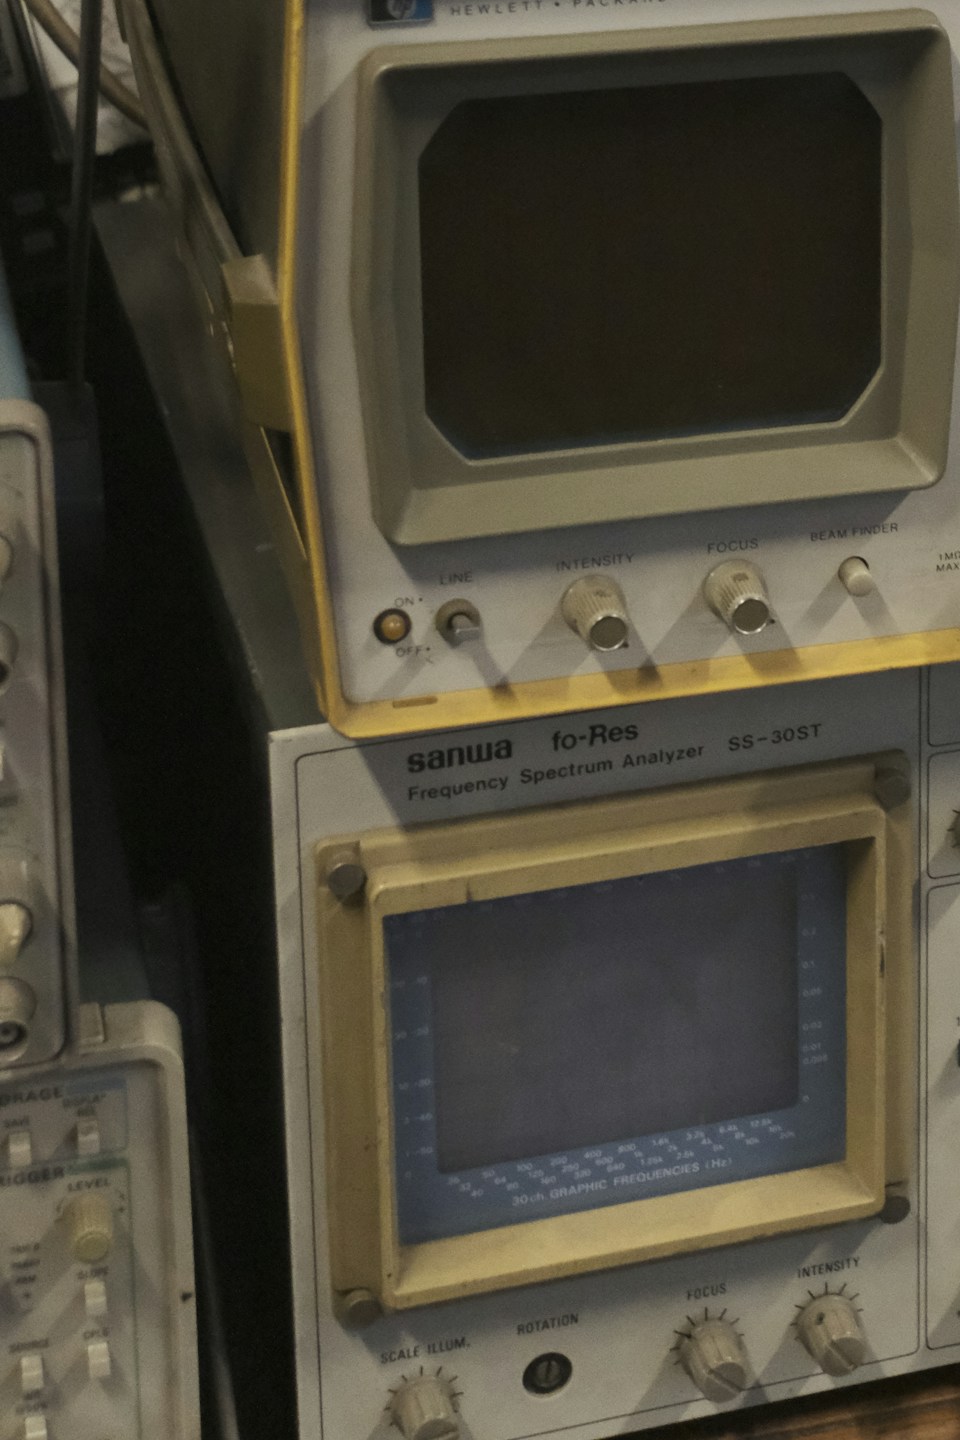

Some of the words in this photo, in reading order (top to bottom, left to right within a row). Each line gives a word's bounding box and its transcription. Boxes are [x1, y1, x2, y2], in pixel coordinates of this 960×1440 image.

[811, 528, 850, 542] BEAM
[853, 522, 899, 538] FINDER
[707, 538, 759, 554] FOCUS
[556, 552, 635, 572] INTENSITY
[438, 570, 474, 585] LINE
[407, 738, 513, 773] sanwa
[552, 722, 639, 752] fo-Res
[408, 774, 509, 802] Frequency
[520, 759, 613, 785] Spectrum
[622, 744, 704, 769] Analyzer
[728, 724, 823, 751] SS-30ST
[550, 1178, 608, 1201] GRAPHIC
[613, 1162, 700, 1188] FREQUENCIES
[798, 1256, 860, 1280] INTENSITY
[687, 1282, 727, 1302] FOCUS
[517, 1312, 579, 1336] ROTATION
[380, 1344, 420, 1365] SCALE
[426, 1336, 471, 1356] ILLUM.
